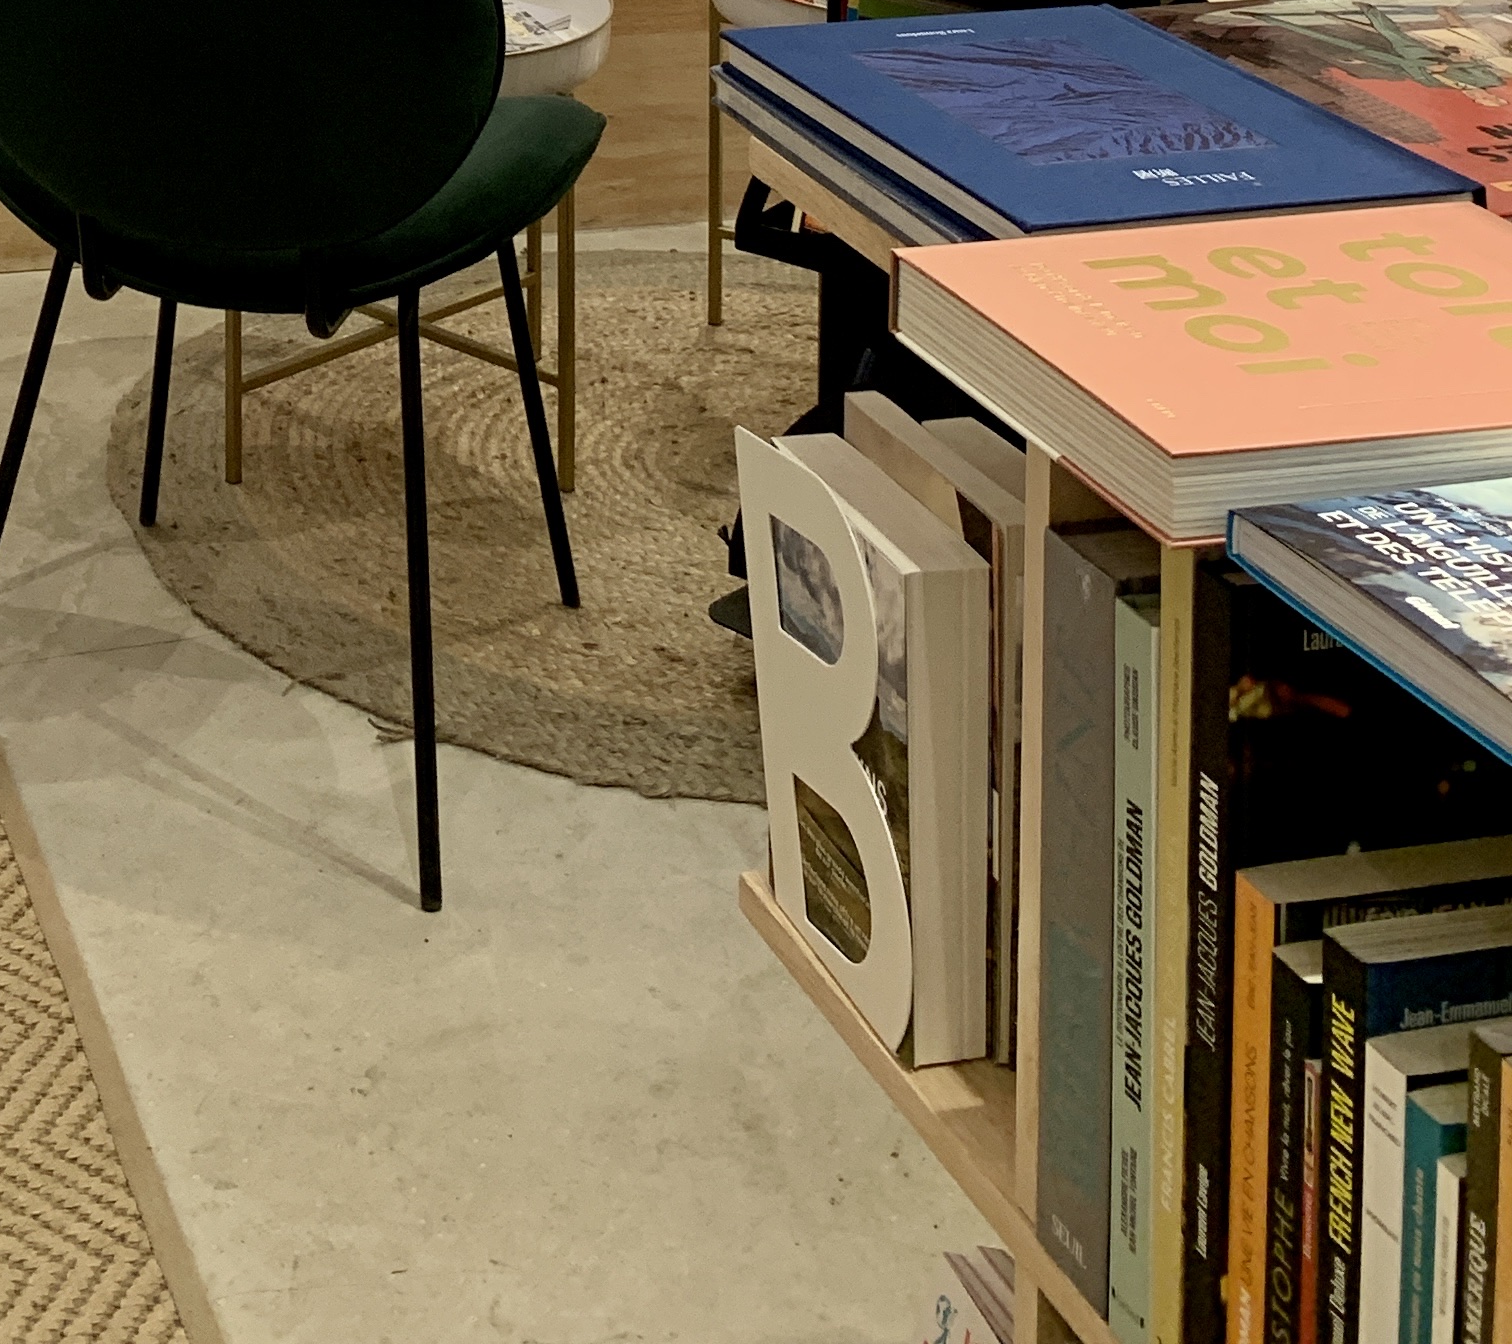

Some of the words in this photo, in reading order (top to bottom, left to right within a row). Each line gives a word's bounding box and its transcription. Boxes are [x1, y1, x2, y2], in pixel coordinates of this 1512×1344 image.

[1207, 245, 1369, 310] et
[1082, 254, 1381, 376] moi
[1317, 508, 1371, 531] ET
[1355, 531, 1425, 565] DES
[1394, 500, 1465, 536] UNE
[1125, 799, 1144, 930] GOLDMAN
[1197, 771, 1219, 892] GOLDMAN
[1196, 891, 1218, 1052] JEAN-JACQUES
[1124, 931, 1144, 1112] JEAN-JACQUES
[1331, 992, 1356, 1080] WAVE
[1398, 996, 1512, 1032] Jean-Emmanuel
[1161, 1015, 1178, 1106] CABREL
[1242, 1044, 1258, 1163] CHANSONS
[1329, 1079, 1354, 1153] NEW
[1160, 1109, 1175, 1213] FRANCIS
[1242, 1168, 1255, 1201] EN
[1280, 1149, 1291, 1181] Vivre
[1195, 1204, 1208, 1260] Laurent
[1241, 1206, 1254, 1237] VIE
[1328, 1145, 1354, 1255] FRENCH
[1051, 1214, 1087, 1270] SEUIL
[1329, 1256, 1346, 1314] Deluxe
